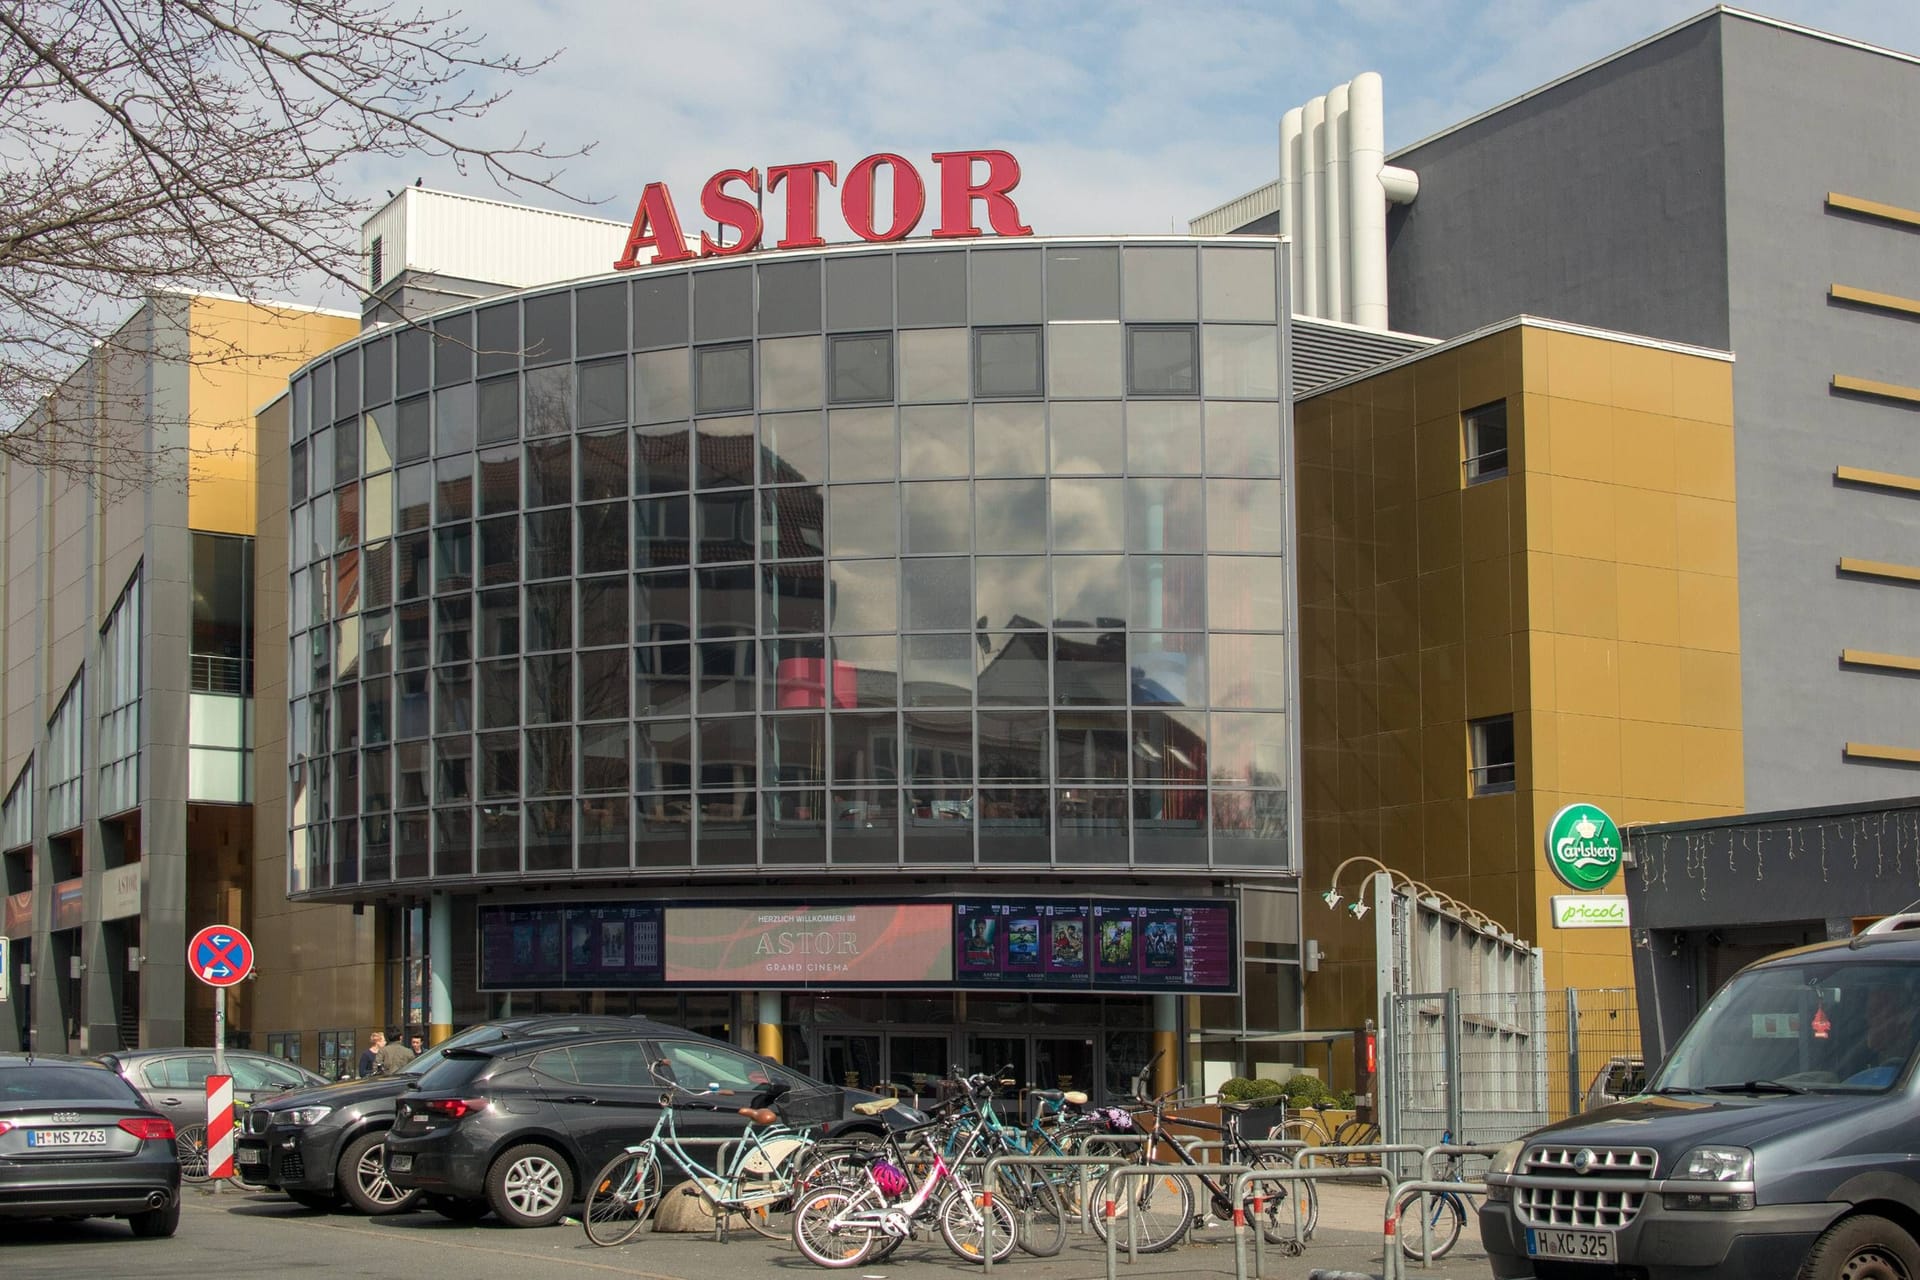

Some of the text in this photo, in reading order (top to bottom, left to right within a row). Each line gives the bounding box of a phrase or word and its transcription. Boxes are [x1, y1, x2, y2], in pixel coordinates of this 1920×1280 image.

[613, 149, 1033, 270] ASTOR
[1557, 837, 1618, 863] Carlsberg
[758, 914, 856, 923] HERZLICH WILLKOMMEN IM
[1562, 904, 1624, 922] piccoli
[755, 932, 860, 955] ASTOR
[766, 963, 849, 972] GRAND CINEMA
[36, 1130, 105, 1144] H MS 7263
[1538, 1231, 1608, 1256] H XC 325
